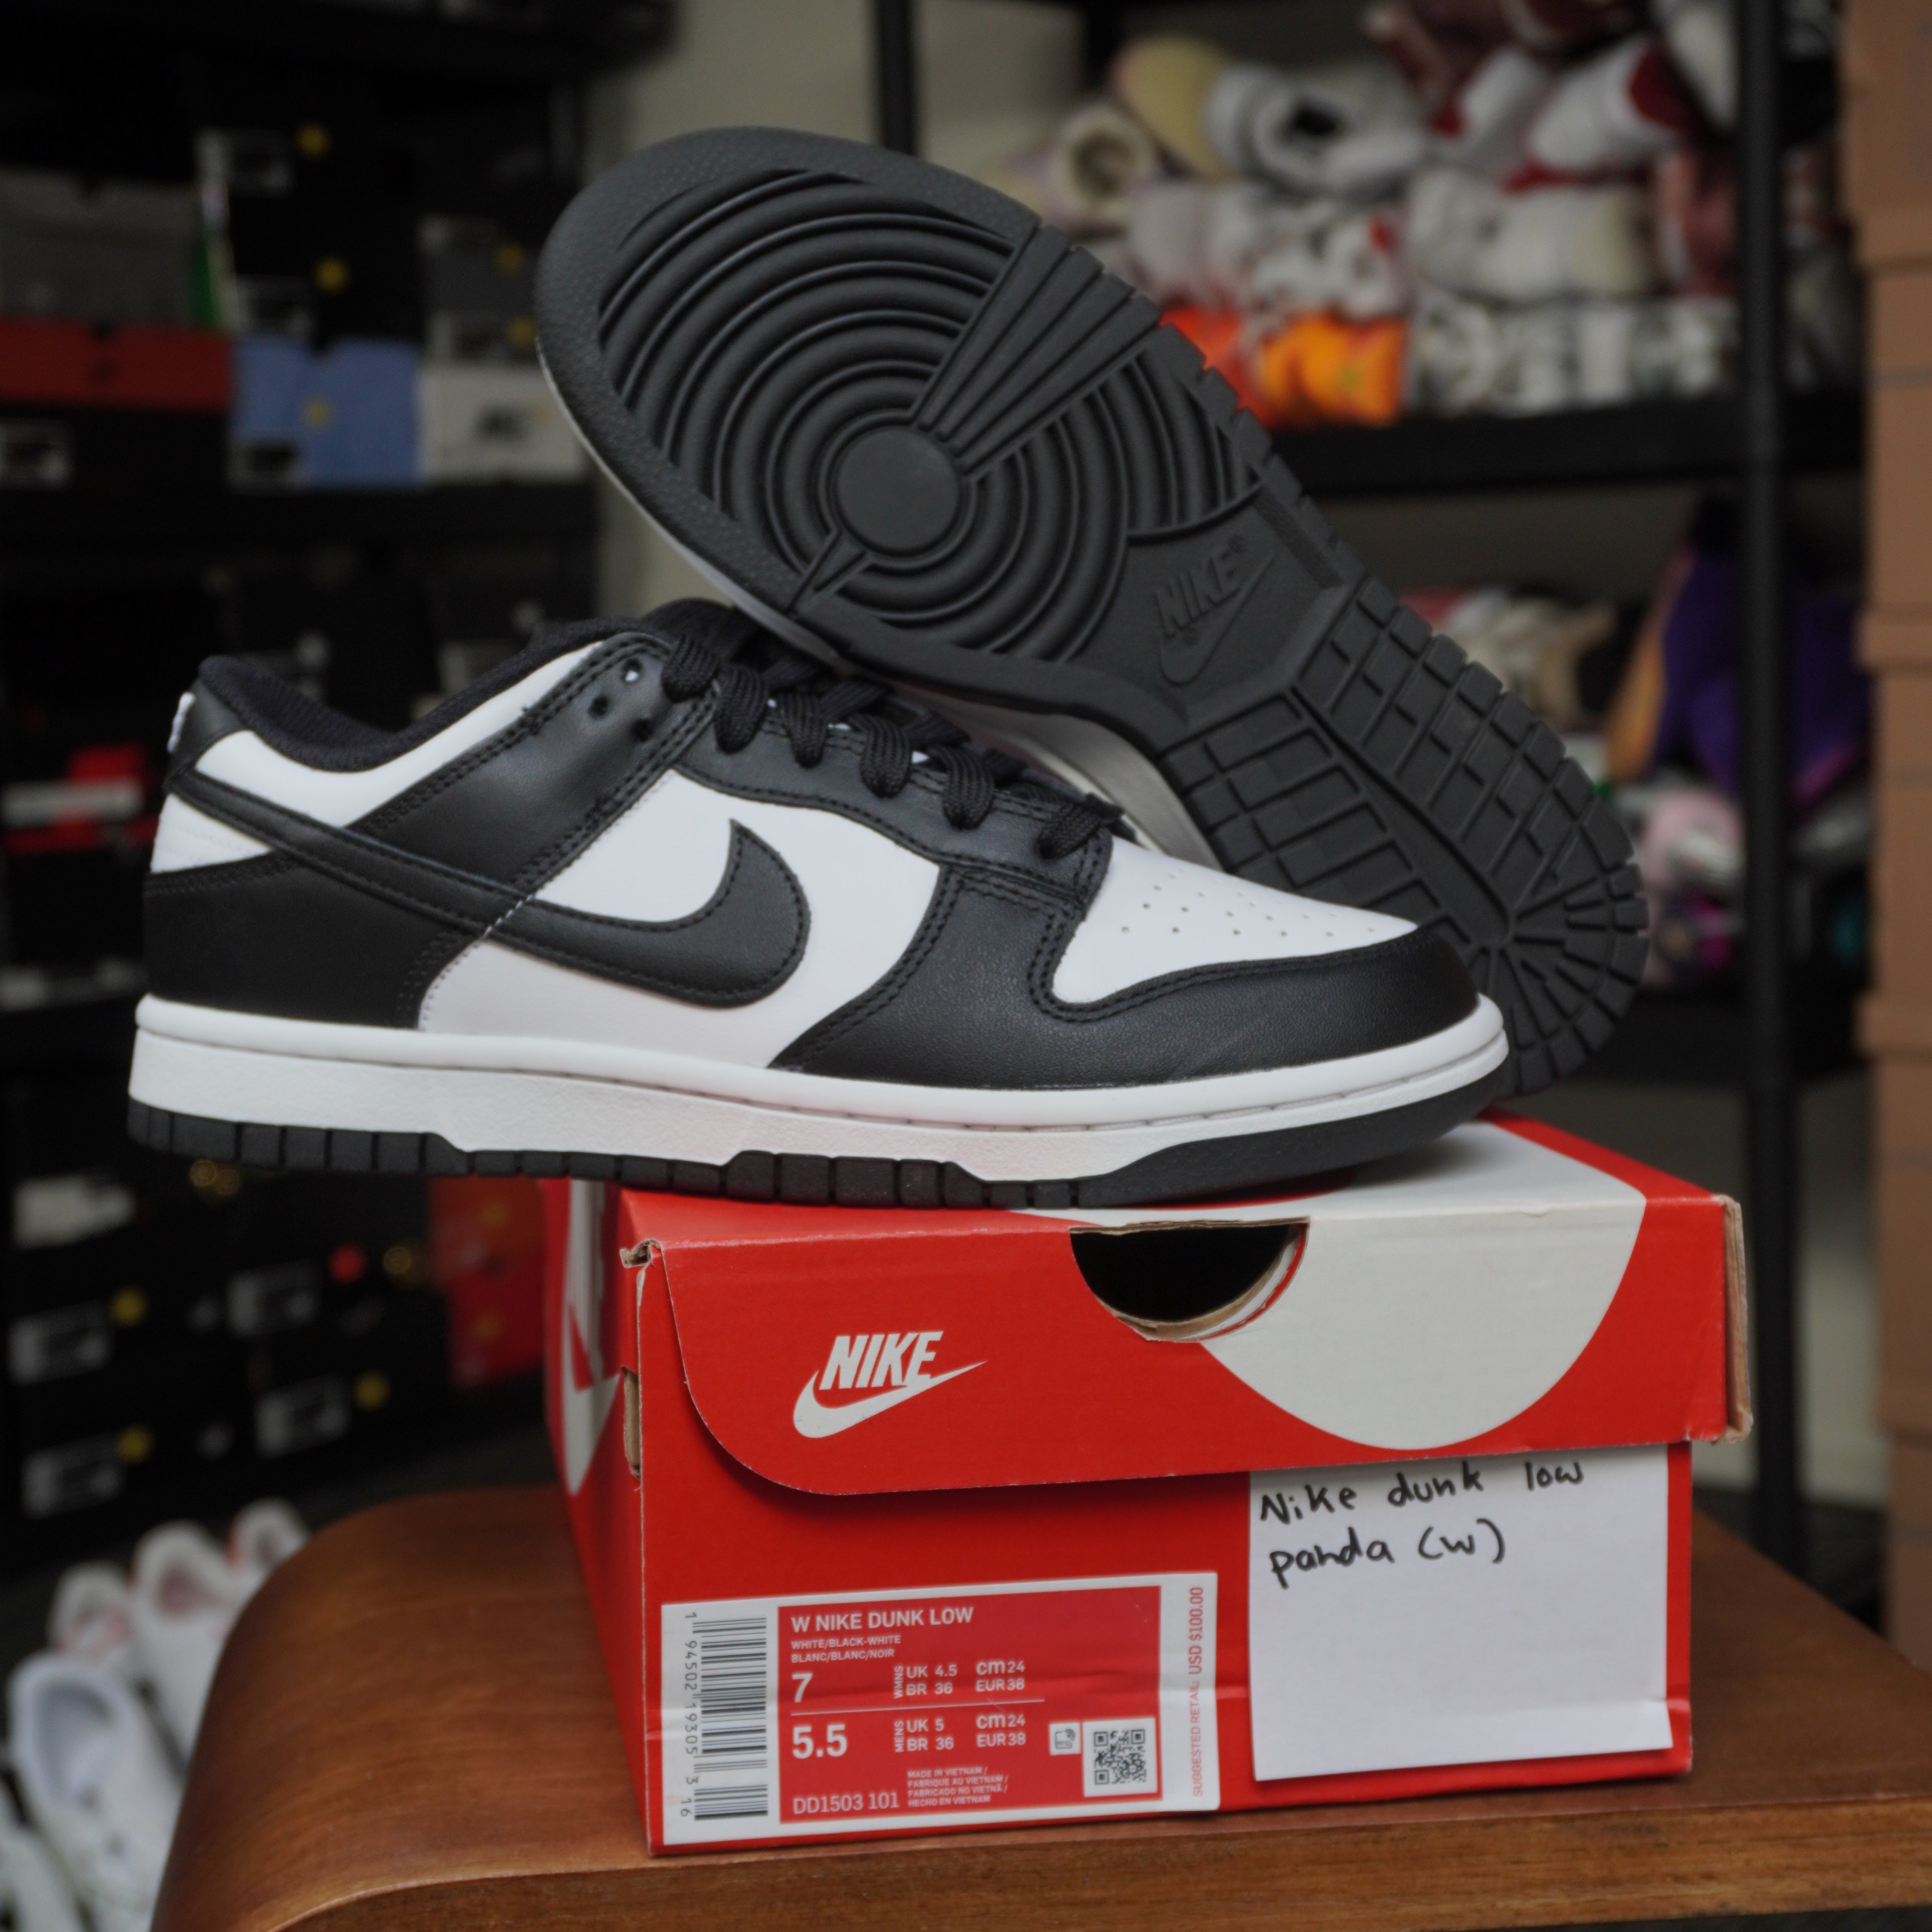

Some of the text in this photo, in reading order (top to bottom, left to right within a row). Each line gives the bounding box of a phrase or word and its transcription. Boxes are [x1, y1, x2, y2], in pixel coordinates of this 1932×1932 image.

[1154, 536, 1243, 638] NIKE
[819, 1331, 944, 1390] NIKE
[1259, 1460, 1584, 1524] Nike dunk low
[1269, 1526, 1395, 1589] panda
[791, 1607, 974, 1633] W NIKE DUNK LOW
[1189, 1586, 1203, 1641] $100.00
[791, 1635, 901, 1649] WHITE/BLACK-WHITE
[791, 1649, 895, 1663] BLANC/BLANC/NOIR
[685, 1641, 697, 1691] 94502
[906, 1664, 957, 1678] UK 4.5
[1188, 1645, 1202, 1674] USD
[791, 1672, 813, 1703] 7
[894, 1665, 904, 1699] WMNS
[906, 1682, 953, 1696] BR 36
[685, 1703, 698, 1754] 19305
[894, 1720, 905, 1753] MENS
[907, 1718, 945, 1733] UK 5
[792, 1724, 848, 1759] 5.5
[907, 1736, 954, 1751] BR 36
[908, 1770, 931, 1778] MADE
[945, 1766, 983, 1776] VIETNAM
[1191, 1727, 1203, 1797] SUGGESTED
[908, 1779, 950, 1788] FABRIQUE
[952, 1778, 963, 1786] AU
[965, 1775, 1003, 1785] VIETNAM
[908, 1788, 956, 1798] FABRICADO
[958, 1787, 970, 1795] NO
[793, 1792, 900, 1814] DD1503 101
[908, 1795, 991, 1807] HECHO EN VIETNAM
